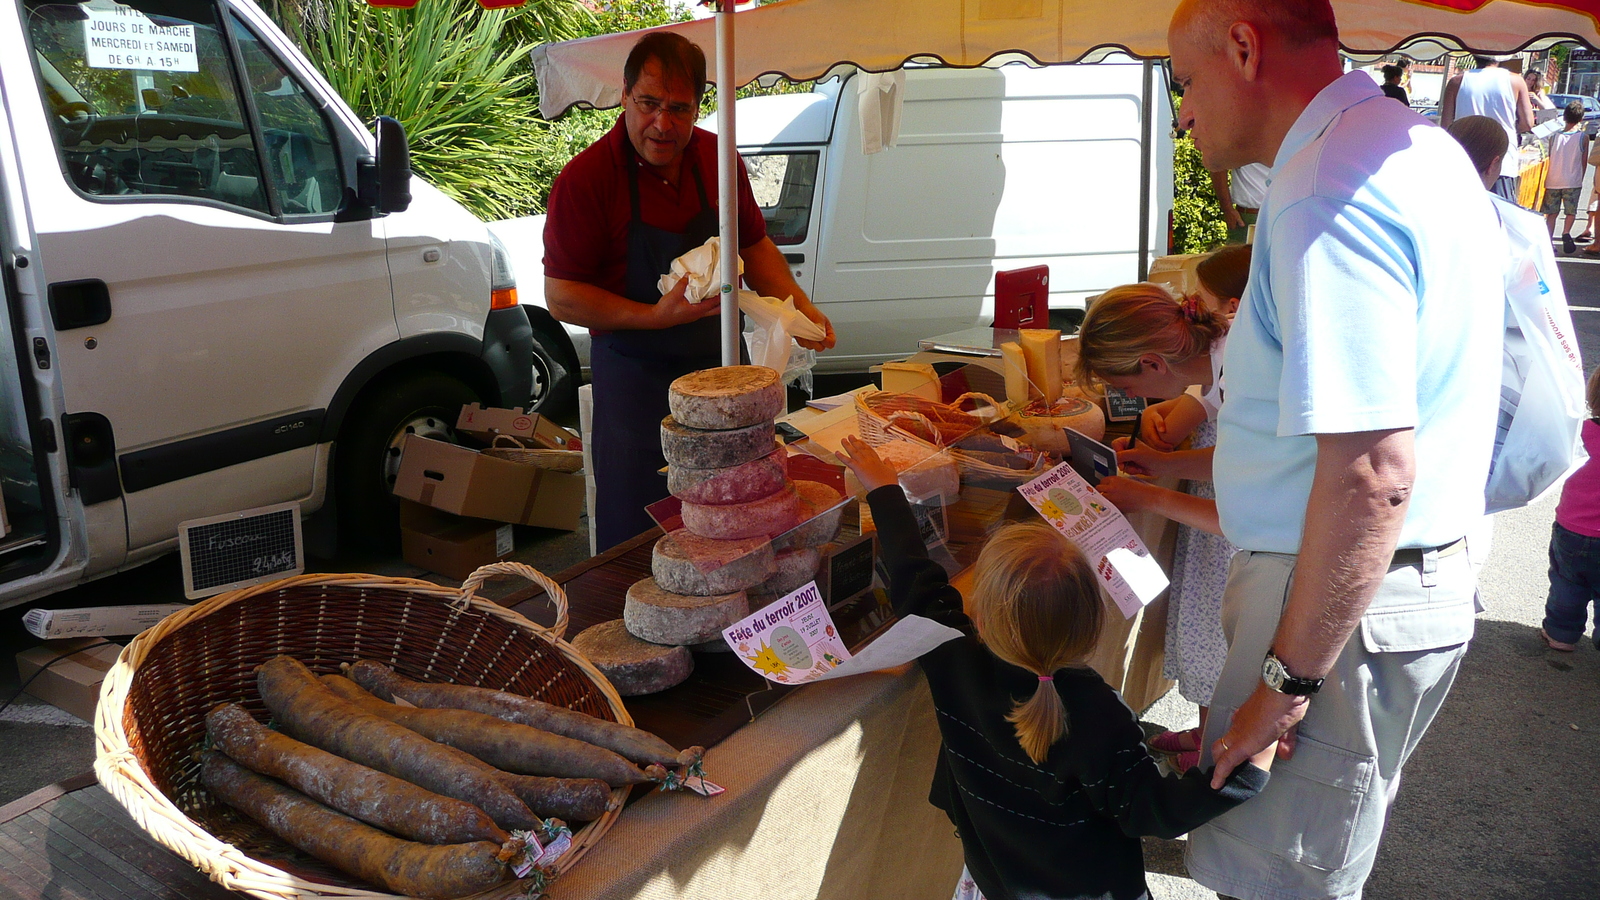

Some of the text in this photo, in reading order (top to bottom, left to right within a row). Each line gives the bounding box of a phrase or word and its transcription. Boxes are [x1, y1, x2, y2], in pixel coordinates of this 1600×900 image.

[91, 20, 191, 37] JOURS DE MARCHE
[91, 37, 193, 53] MERCREDI ET SAMEDI
[109, 54, 122, 65] DE
[126, 55, 140, 65] 6H
[159, 57, 180, 67] 15H
[1560, 339, 1571, 353] ses
[1021, 486, 1037, 497] Fête
[1033, 483, 1044, 493] du
[1040, 473, 1060, 489] terroir
[1056, 464, 1073, 478] 2007
[728, 586, 818, 643] Fête du terroir 2007
